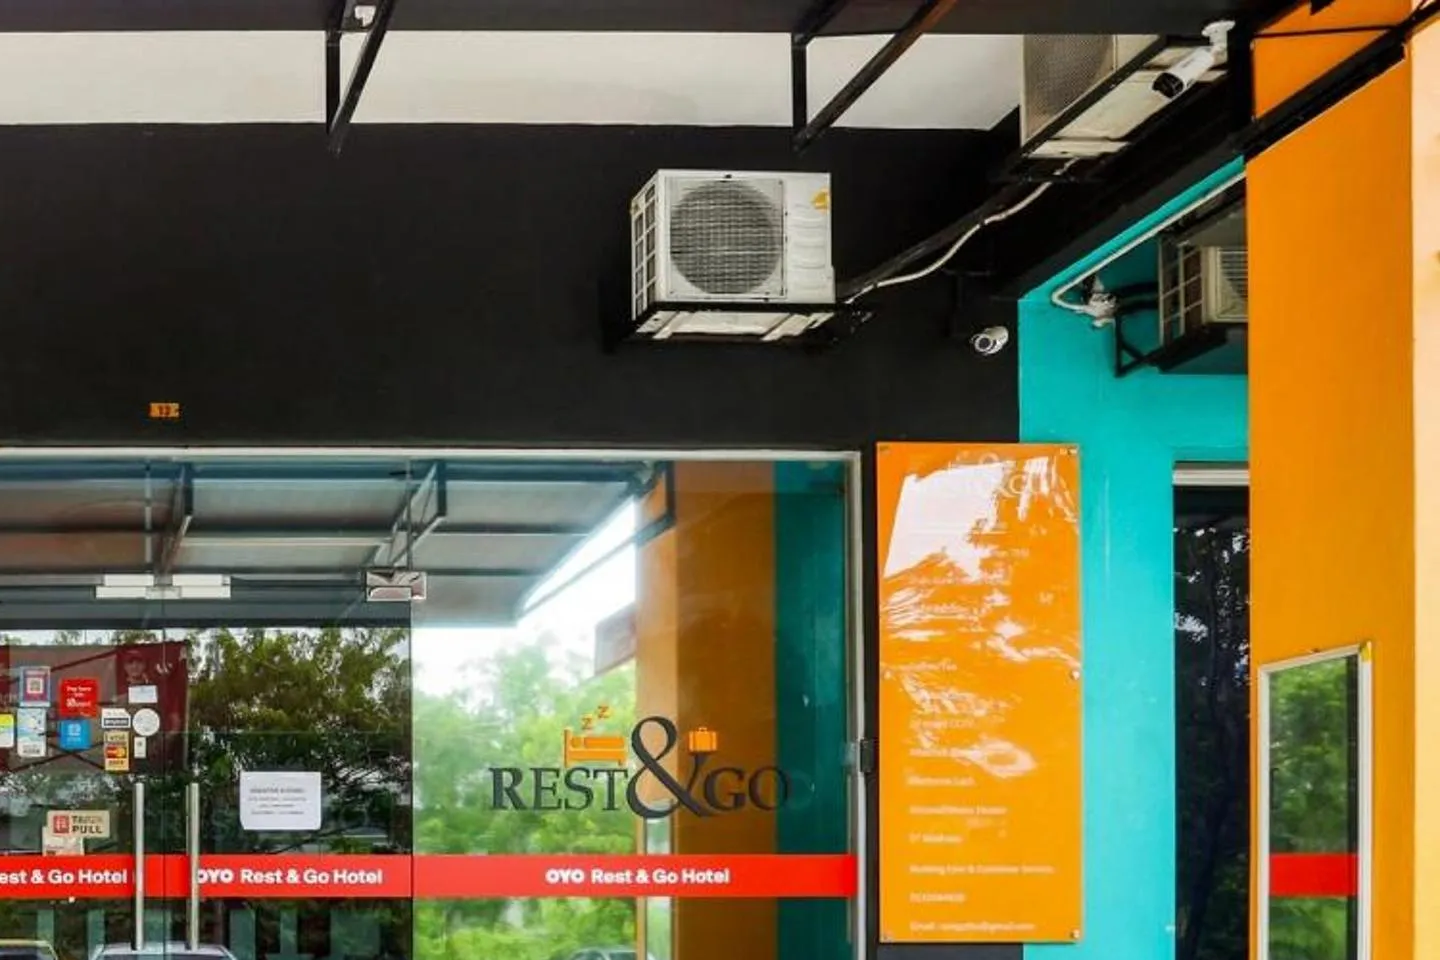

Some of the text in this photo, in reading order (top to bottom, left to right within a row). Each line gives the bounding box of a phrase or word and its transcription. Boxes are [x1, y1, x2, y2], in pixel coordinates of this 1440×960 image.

[72, 825, 103, 834] PULL
[30, 869, 45, 885] &
[47, 869, 75, 885] Go
[78, 869, 128, 885] Hotel
[240, 868, 283, 884] Rest
[285, 868, 300, 884] &
[302, 868, 330, 884] Go
[333, 868, 383, 884] Hotel
[545, 868, 730, 884] OYO Rest & Go Hotel
